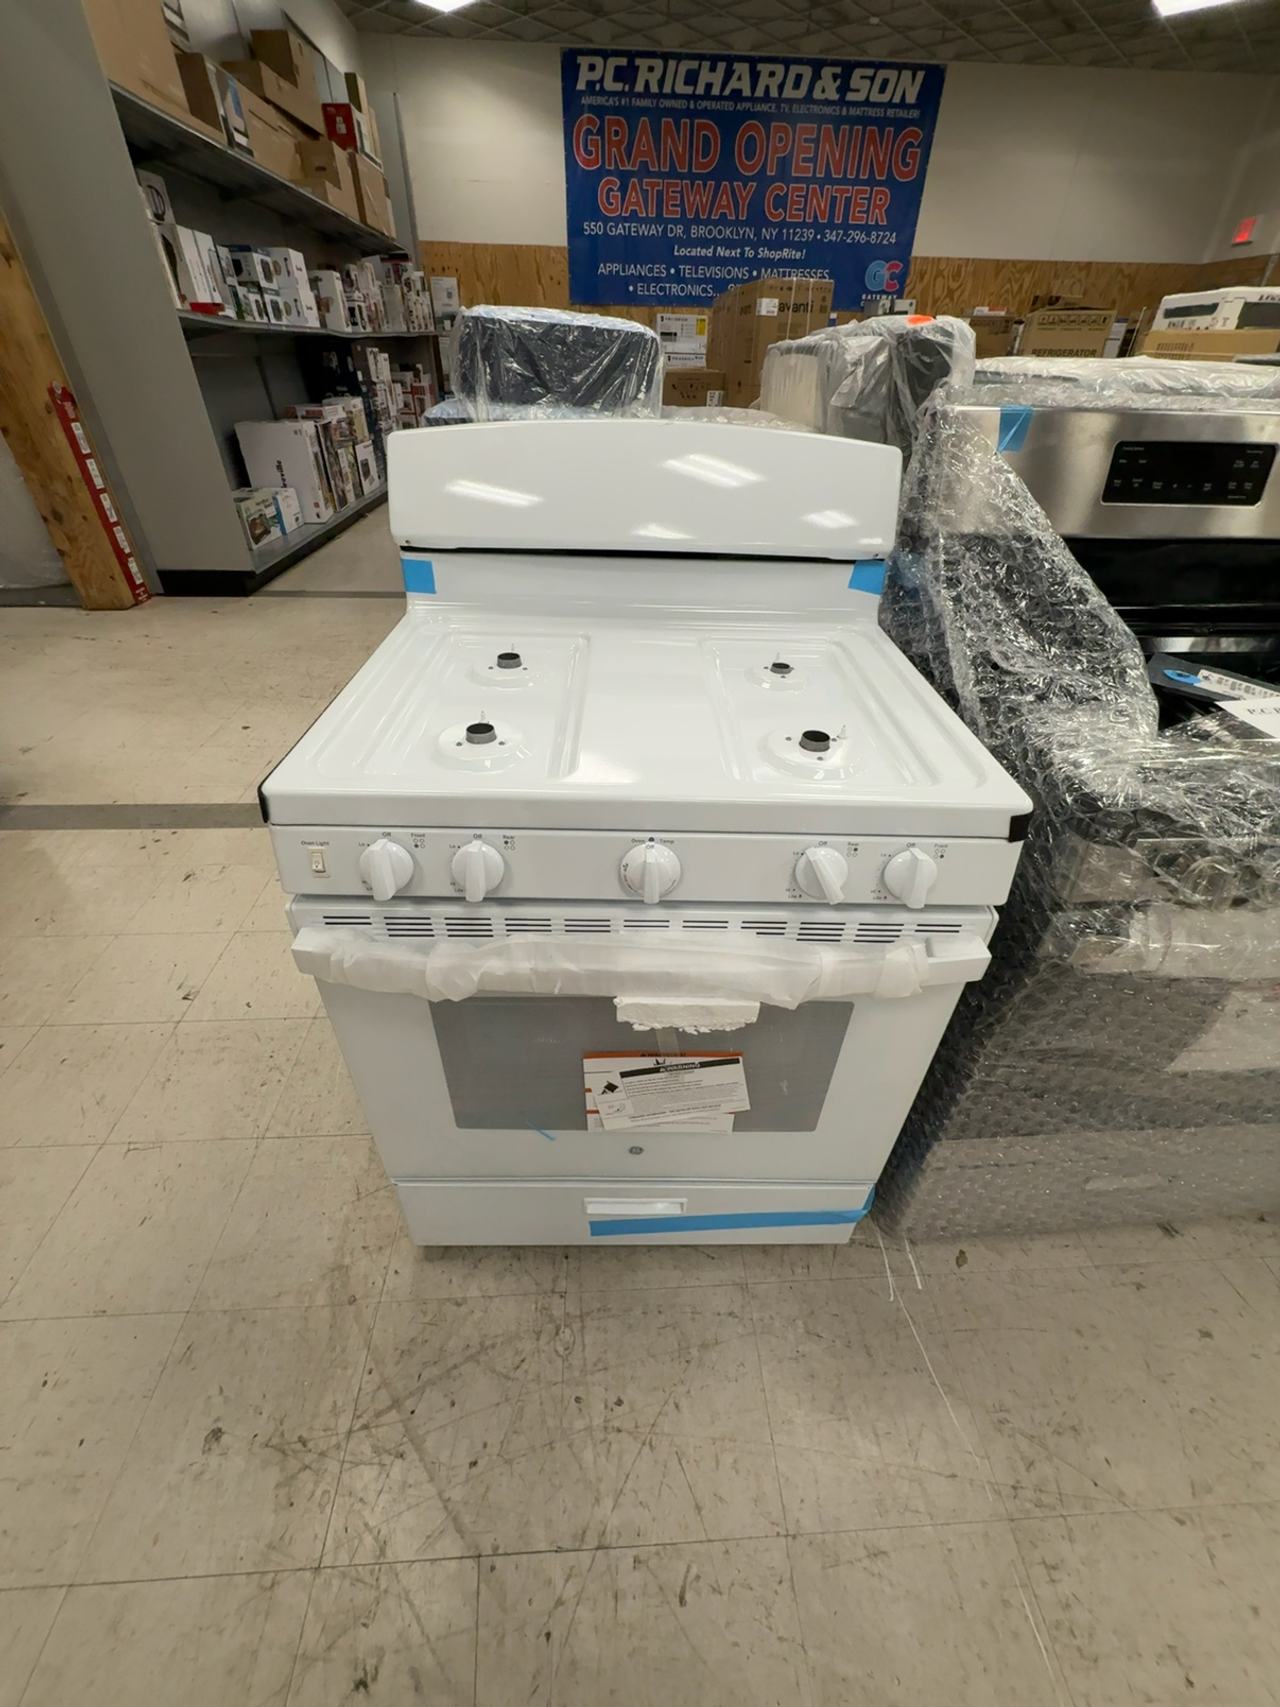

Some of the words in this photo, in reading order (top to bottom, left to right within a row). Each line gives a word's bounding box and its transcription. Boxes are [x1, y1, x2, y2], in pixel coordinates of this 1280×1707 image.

[575, 56, 629, 92] P.C.
[634, 58, 813, 98] RICHARD
[813, 66, 842, 101] &
[845, 68, 925, 104] SON
[581, 96, 619, 107] AMERICA'S
[621, 97, 630, 106] #1
[631, 98, 657, 108] FAMILY
[659, 99, 688, 109] OWNED
[690, 100, 695, 109] &
[697, 100, 735, 111] OPERATED
[792, 103, 840, 115] ELECTRONICS
[849, 107, 885, 117] MATTRESS
[573, 113, 721, 173] GRAND
[734, 120, 923, 182] OPENING
[597, 176, 757, 220] GATEWAY
[764, 182, 891, 225] CENTER
[583, 222, 604, 235] 550
[606, 222, 664, 237] GATEWAY
[667, 224, 687, 239] DR,
[690, 226, 757, 241] BROOKLYN,
[761, 228, 779, 240] NY
[782, 228, 815, 241] 11239
[823, 230, 897, 245] 347-296-8724
[673, 245, 713, 257] Located
[716, 246, 741, 258] Next
[744, 247, 755, 258] To
[757, 247, 807, 261] ShopRite!
[597, 263, 667, 277] APPLIANCES
[679, 265, 750, 280] TELEVISIONS
[760, 268, 830, 280] MATTRESSES
[778, 300, 815, 314] avanti
[1031, 348, 1098, 358] REFRIGERATOR
